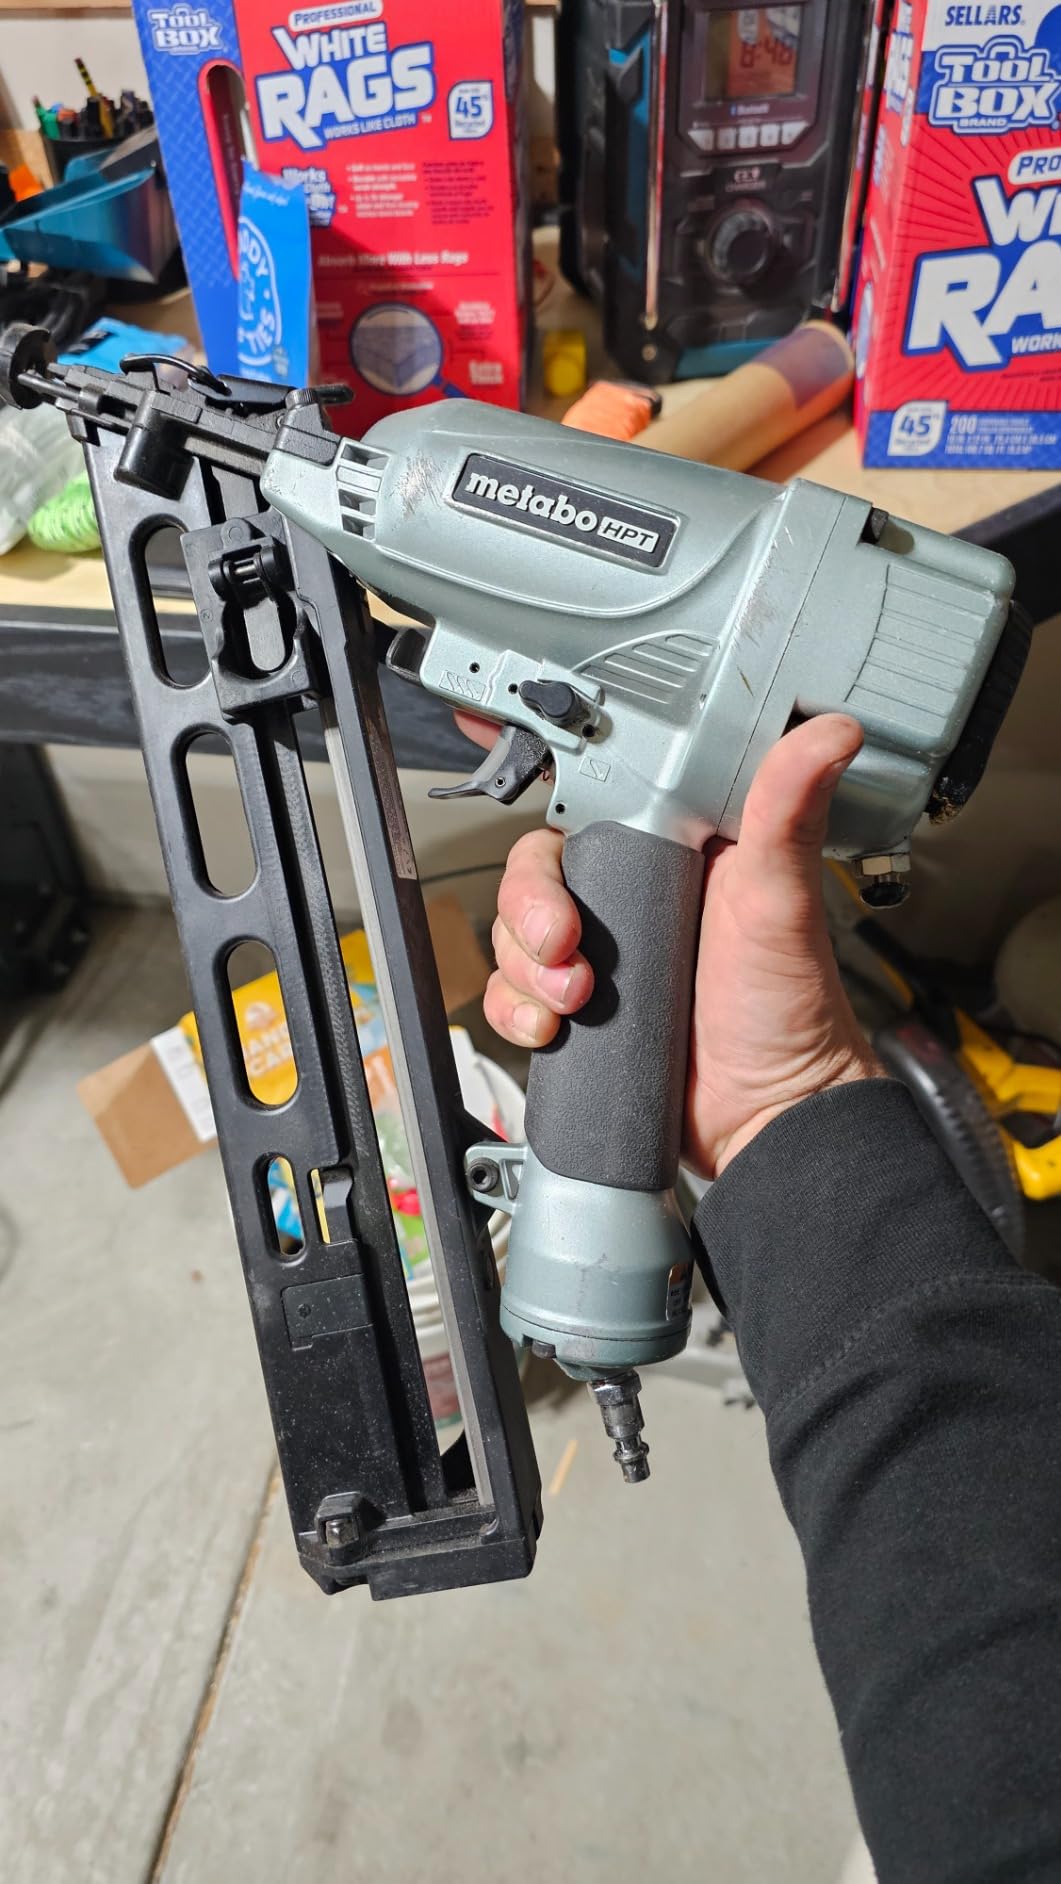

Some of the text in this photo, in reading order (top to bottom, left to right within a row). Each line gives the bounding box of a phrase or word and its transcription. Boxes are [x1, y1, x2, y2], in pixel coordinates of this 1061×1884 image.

[151, 13, 213, 28] TOOL
[294, 1, 377, 26] PROFESSIONAL
[945, 5, 1022, 26] SELLARS
[156, 27, 219, 47] BOX
[271, 22, 387, 70] WHITE
[941, 54, 1053, 83] TOOL
[257, 45, 434, 149] RAGS
[935, 82, 1060, 120] BOX
[323, 113, 417, 139] WORKS LIKE CLOTH
[959, 117, 1008, 128] BRAND
[1016, 155, 1061, 177] PRO
[907, 238, 1061, 367] RA
[464, 472, 657, 549] metabo HPT
